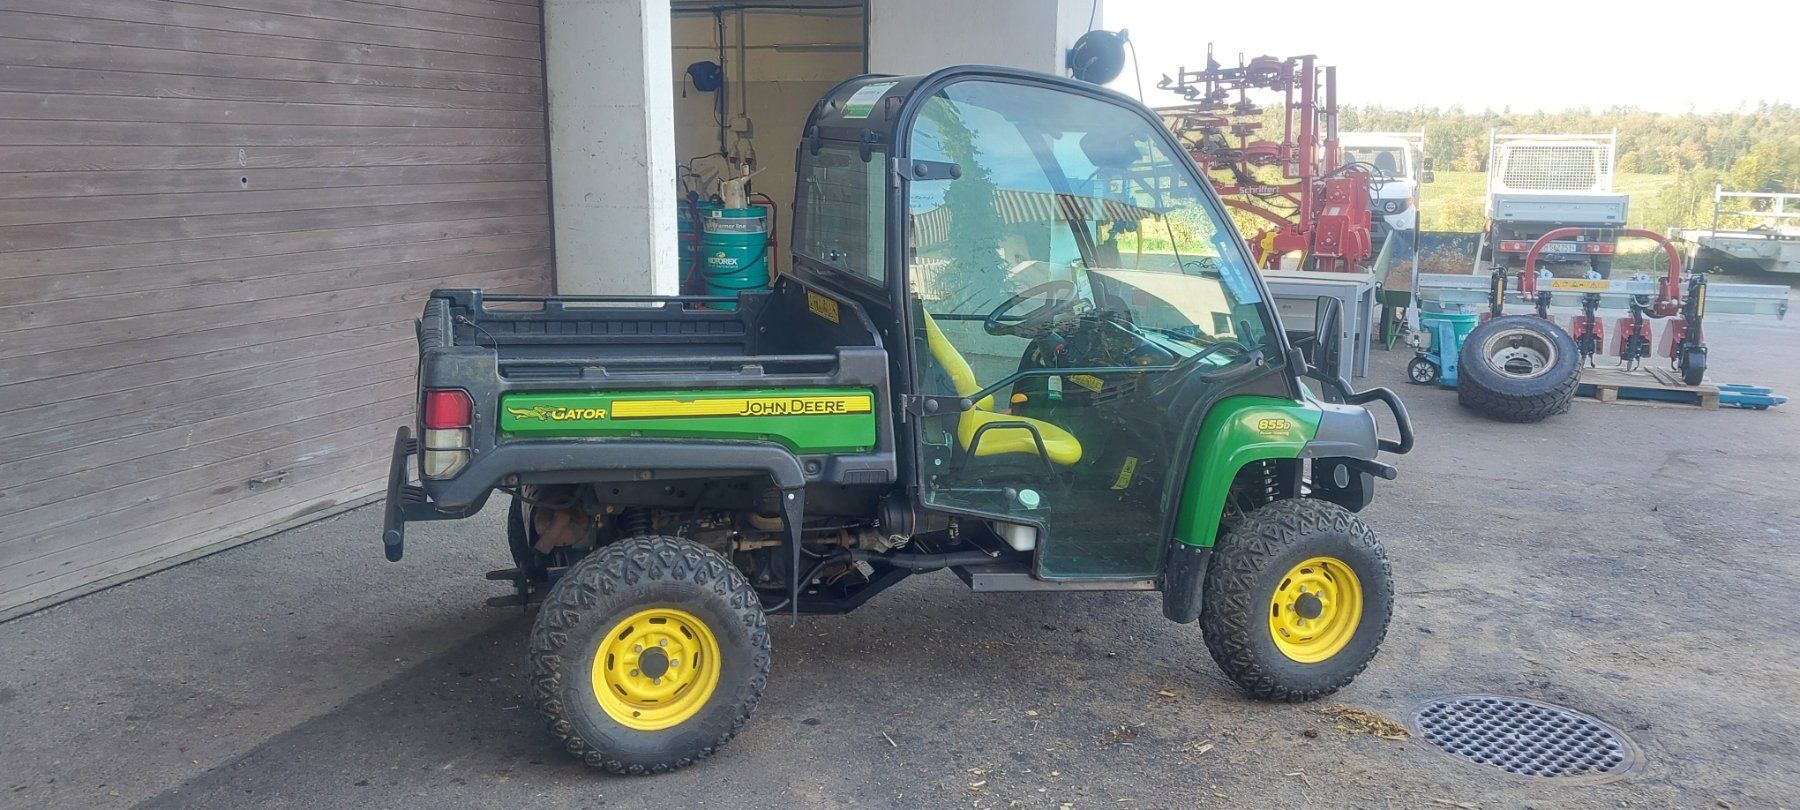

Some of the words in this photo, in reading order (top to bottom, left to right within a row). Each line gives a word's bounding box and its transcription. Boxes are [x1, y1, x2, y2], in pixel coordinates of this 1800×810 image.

[551, 406, 607, 420] GATOR
[740, 400, 786, 414] JOHN
[791, 399, 845, 413] DEERE
[1258, 418, 1291, 430] 855D
